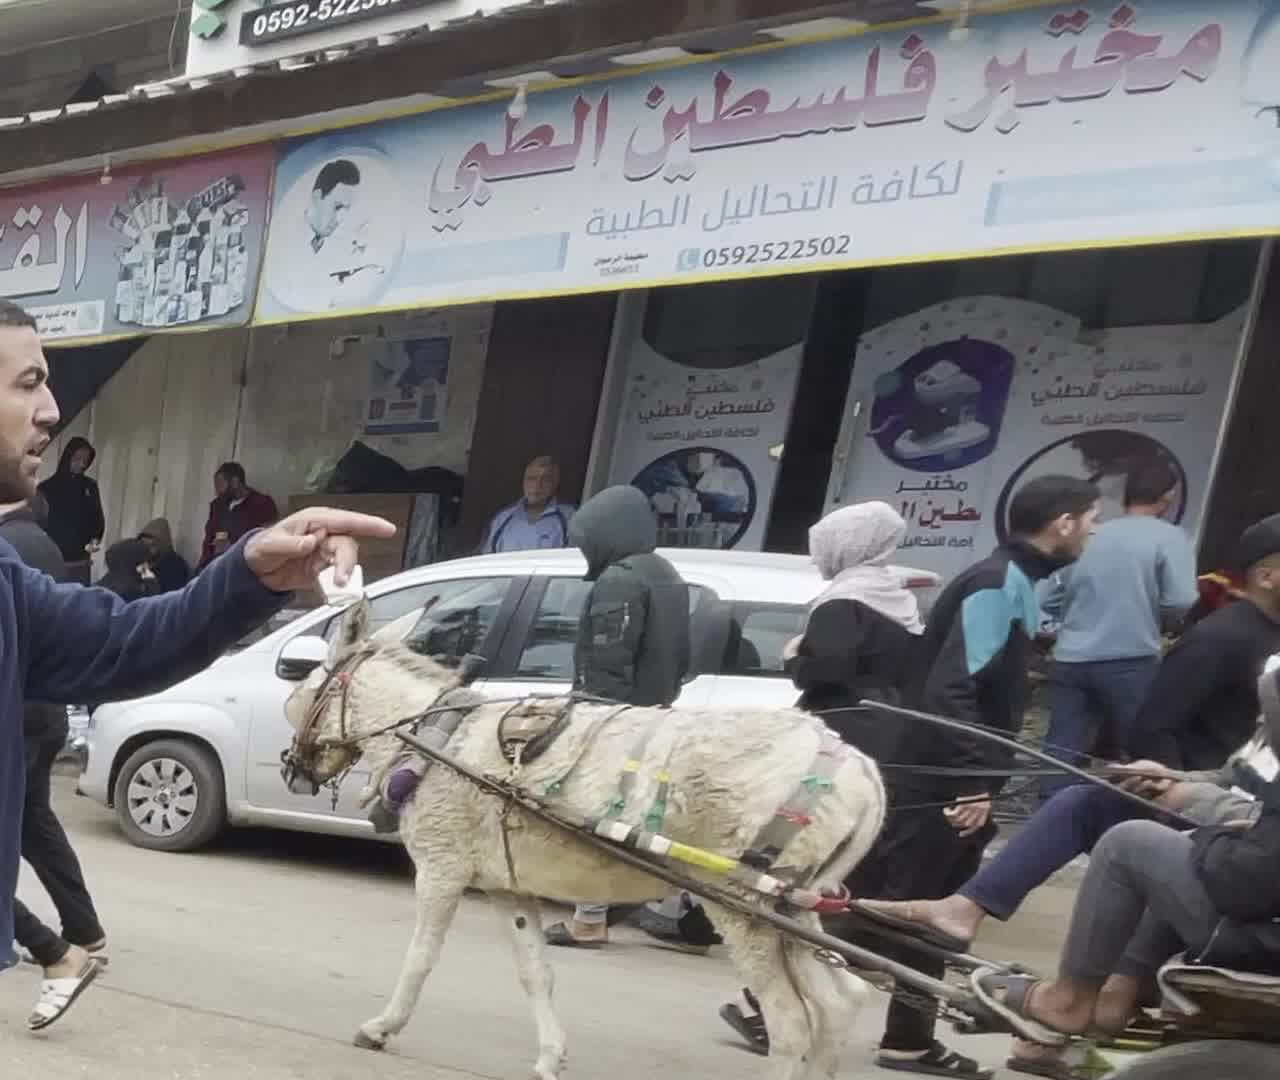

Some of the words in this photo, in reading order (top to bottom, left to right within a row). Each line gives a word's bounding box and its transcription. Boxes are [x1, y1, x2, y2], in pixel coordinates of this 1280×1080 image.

[253, 0, 401, 36] 0592-522
[944, 4, 1225, 134] مختبر
[624, 32, 939, 184] فلسطين
[427, 88, 610, 233] الطبي
[850, 159, 965, 207] لكافة
[585, 193, 692, 240] الطبية
[702, 174, 838, 233] التحاليل
[701, 233, 851, 270] 0592522502
[896, 474, 969, 496] مختبر
